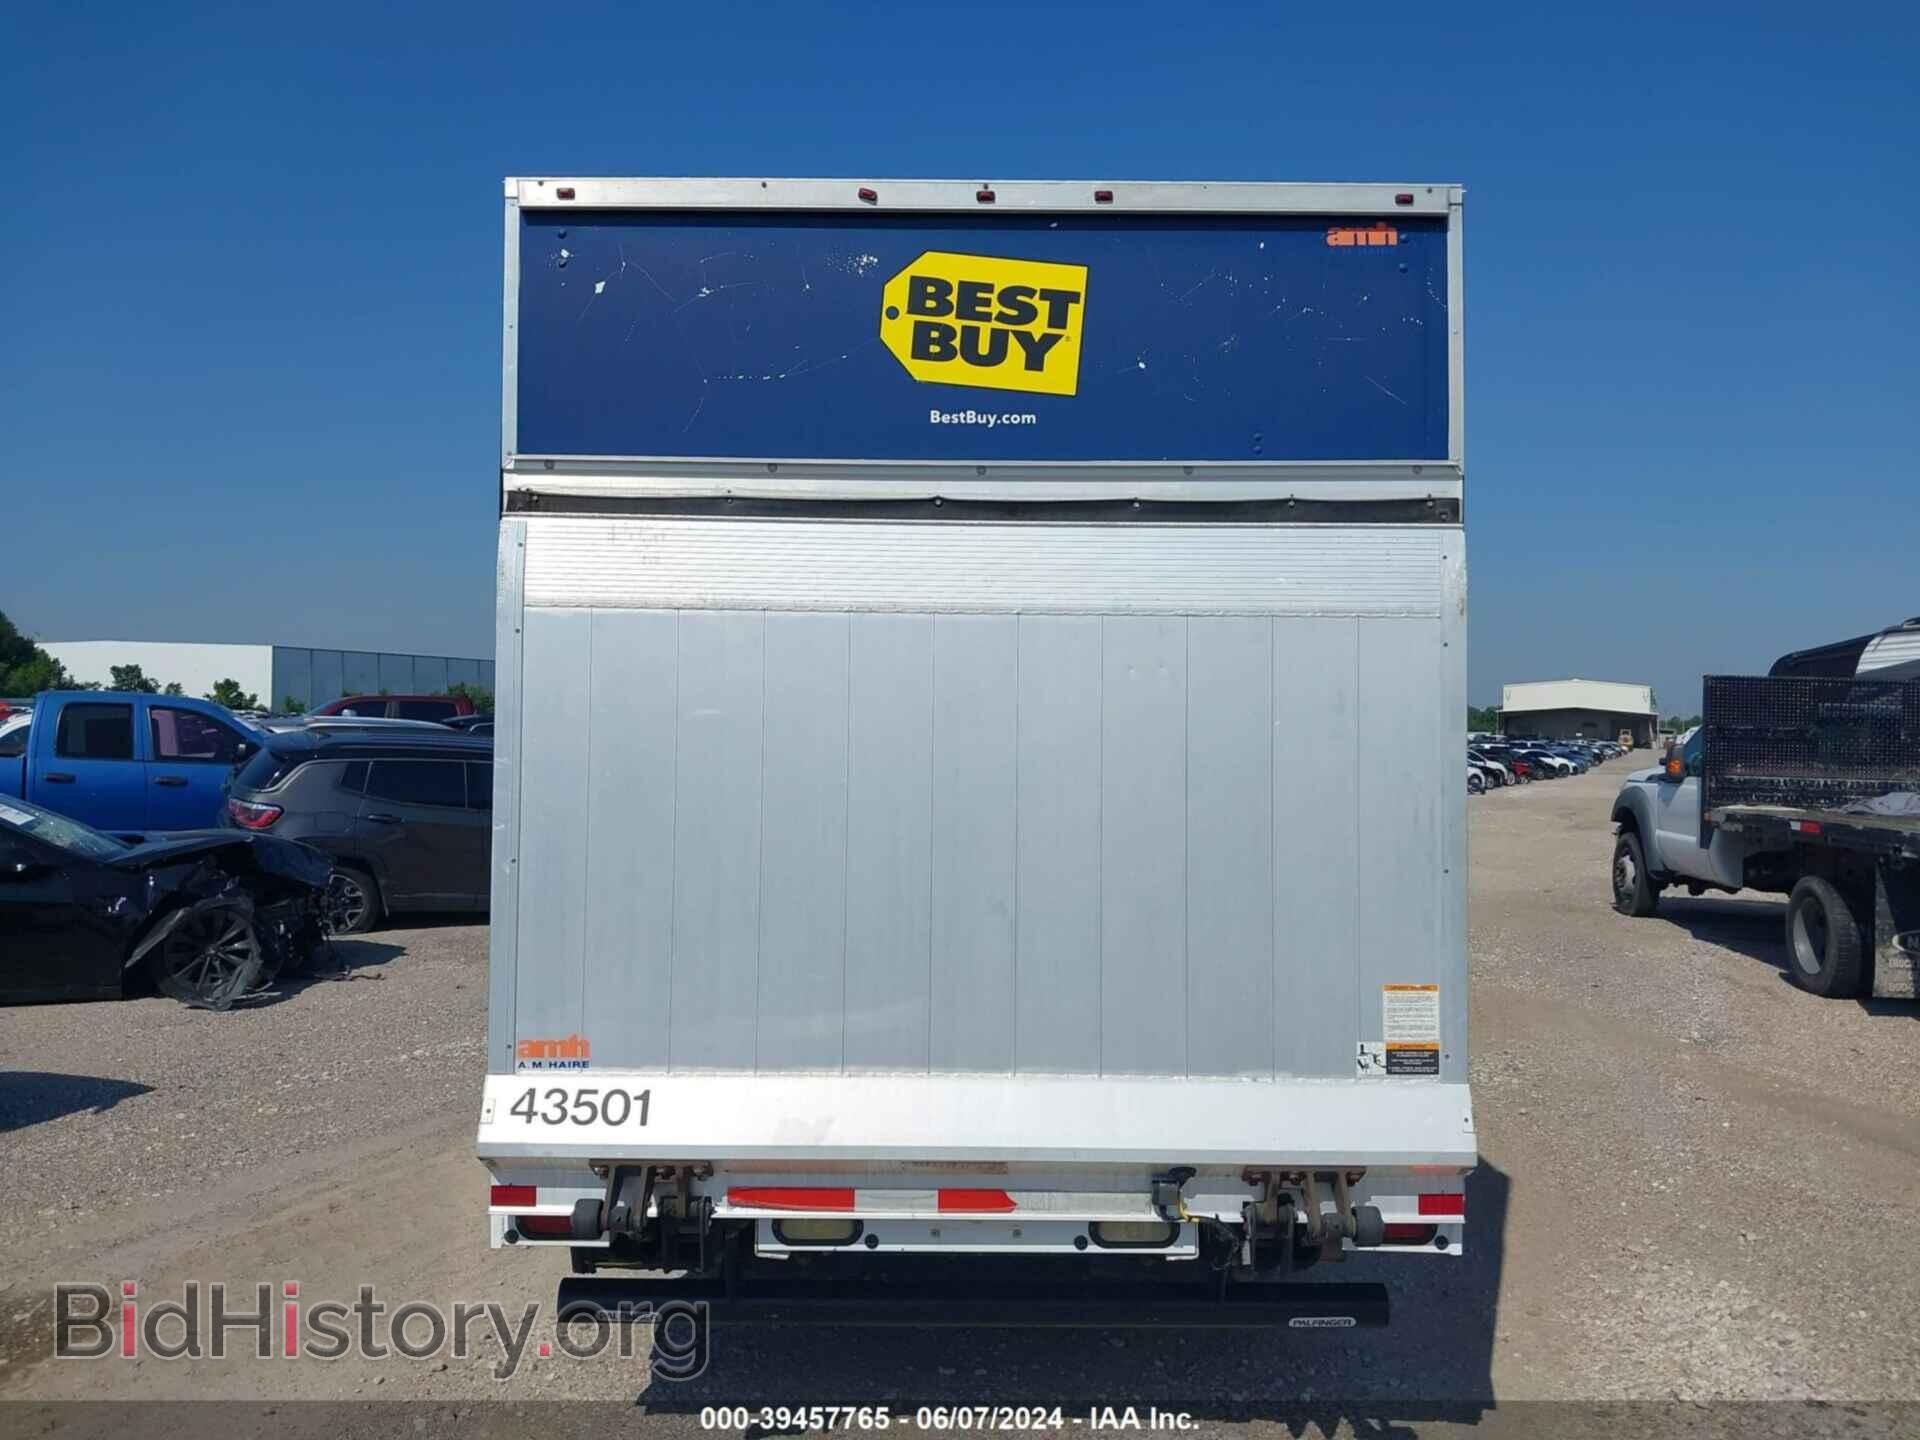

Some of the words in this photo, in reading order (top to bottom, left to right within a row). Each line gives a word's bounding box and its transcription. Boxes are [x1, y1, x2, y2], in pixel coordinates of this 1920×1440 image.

[907, 275, 1081, 330] BEST
[911, 320, 1065, 372] BUY
[929, 410, 1037, 428] BestBuy.com
[548, 1060, 590, 1069] HAIRE
[510, 1087, 651, 1127] 43501
